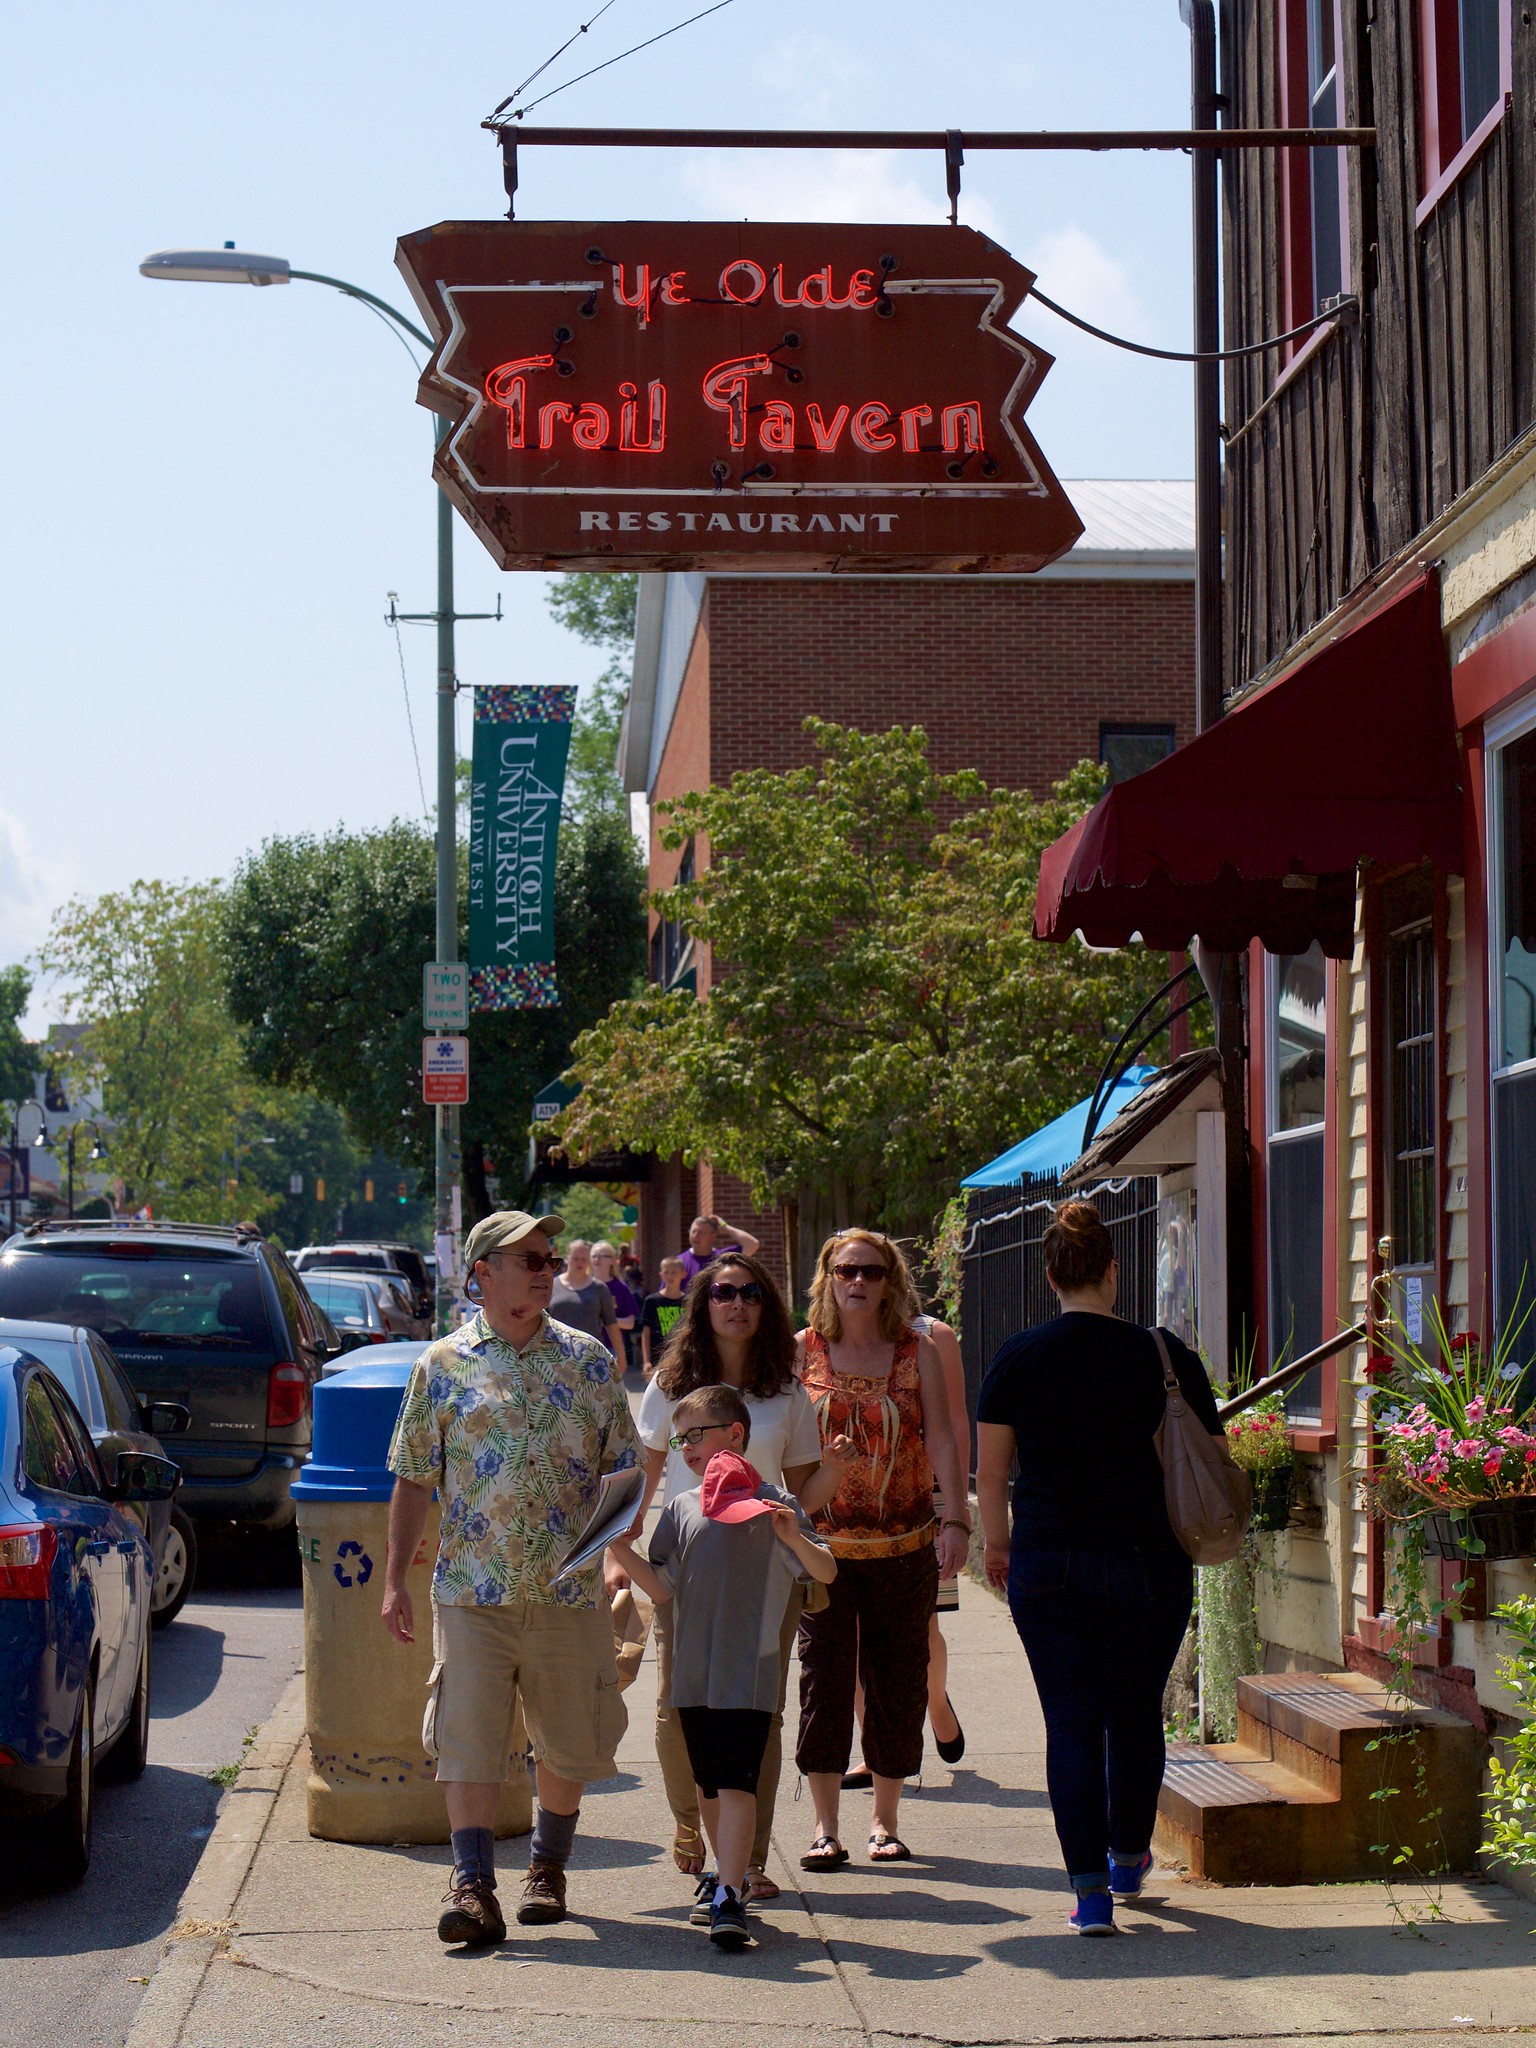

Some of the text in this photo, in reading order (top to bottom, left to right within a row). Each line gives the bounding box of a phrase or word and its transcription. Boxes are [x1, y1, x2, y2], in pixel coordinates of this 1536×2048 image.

[612, 259, 879, 330] Ye Olde
[485, 353, 985, 453] Trail Tavern
[578, 510, 900, 533] RESTAURANT
[470, 782, 486, 909] MIDWEST
[495, 732, 538, 959] UNIVERSITY
[518, 768, 559, 935] ANTIOCH
[432, 973, 461, 986] TWO
[435, 993, 457, 1003] HOUR
[428, 1010, 464, 1018] PARKING
[538, 1105, 558, 1116] ATM
[210, 1422, 258, 1430] SPORT
